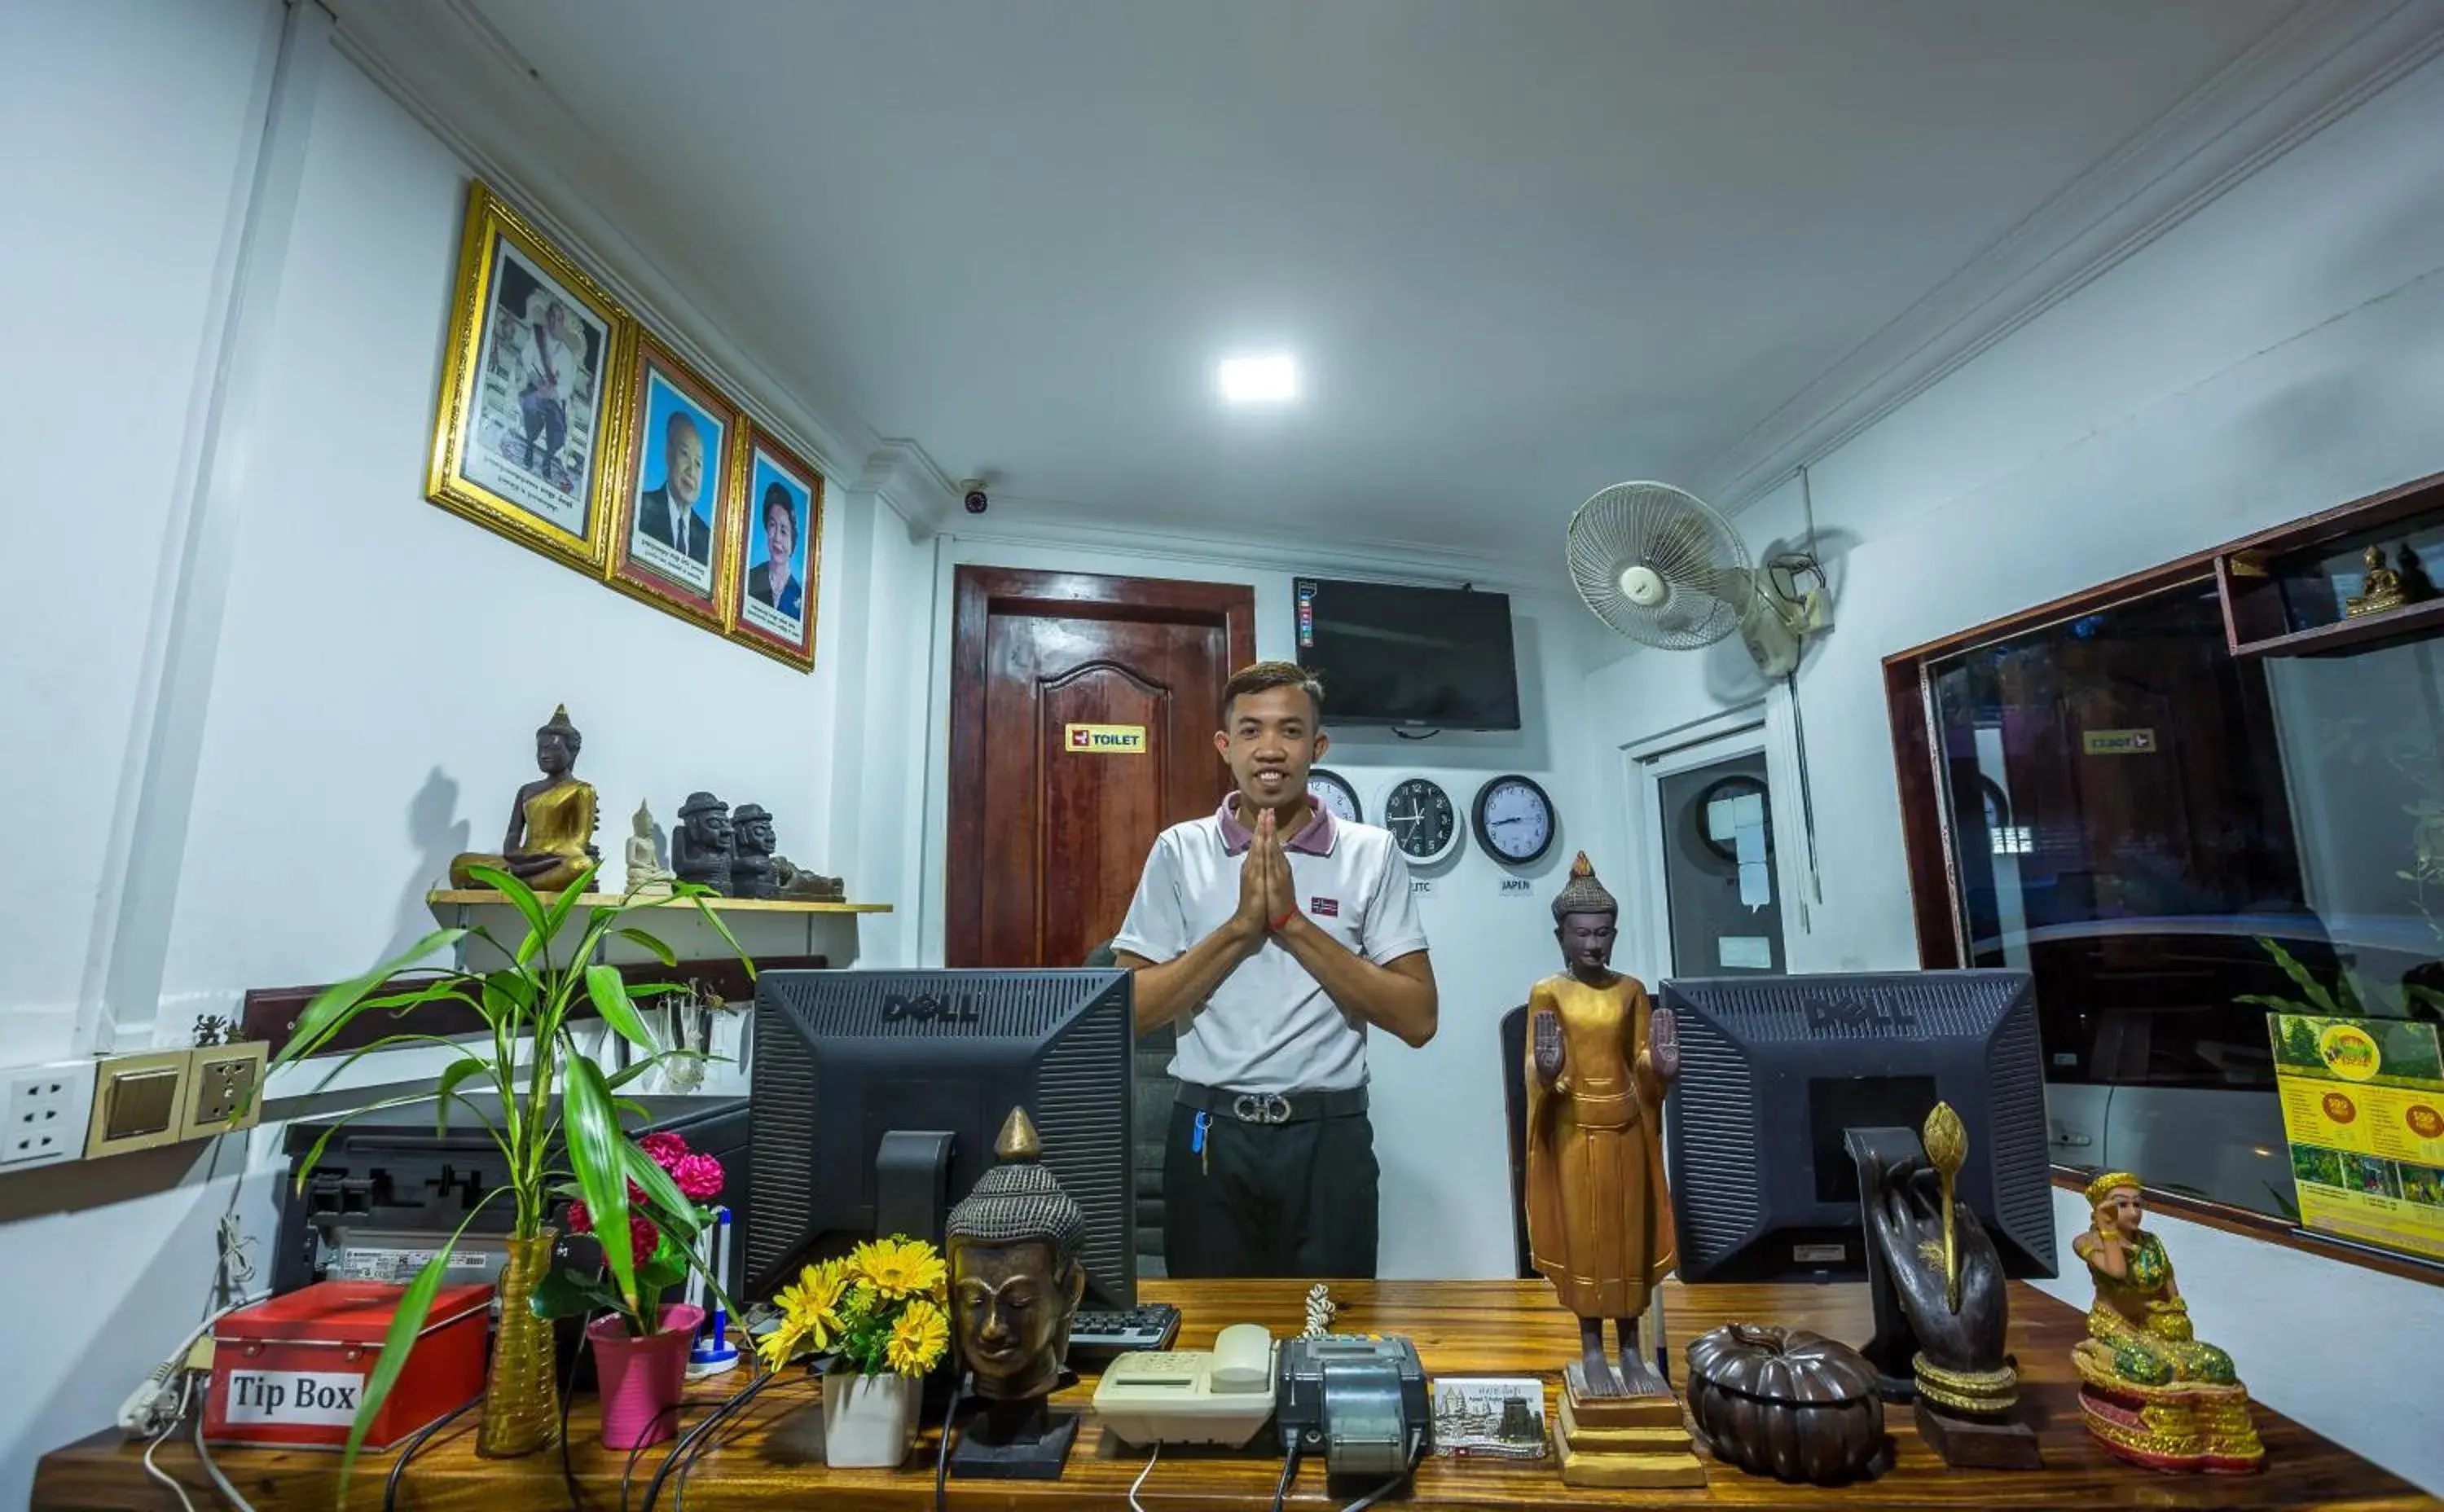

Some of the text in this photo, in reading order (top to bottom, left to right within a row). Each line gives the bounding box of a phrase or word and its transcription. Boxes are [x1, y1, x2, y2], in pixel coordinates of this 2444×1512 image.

[1092, 734, 1140, 745] TOILET
[1412, 784, 1422, 793] 12
[883, 991, 979, 1022] DELL
[1803, 996, 1918, 1026] DELL
[234, 1376, 357, 1415] Tip Box
